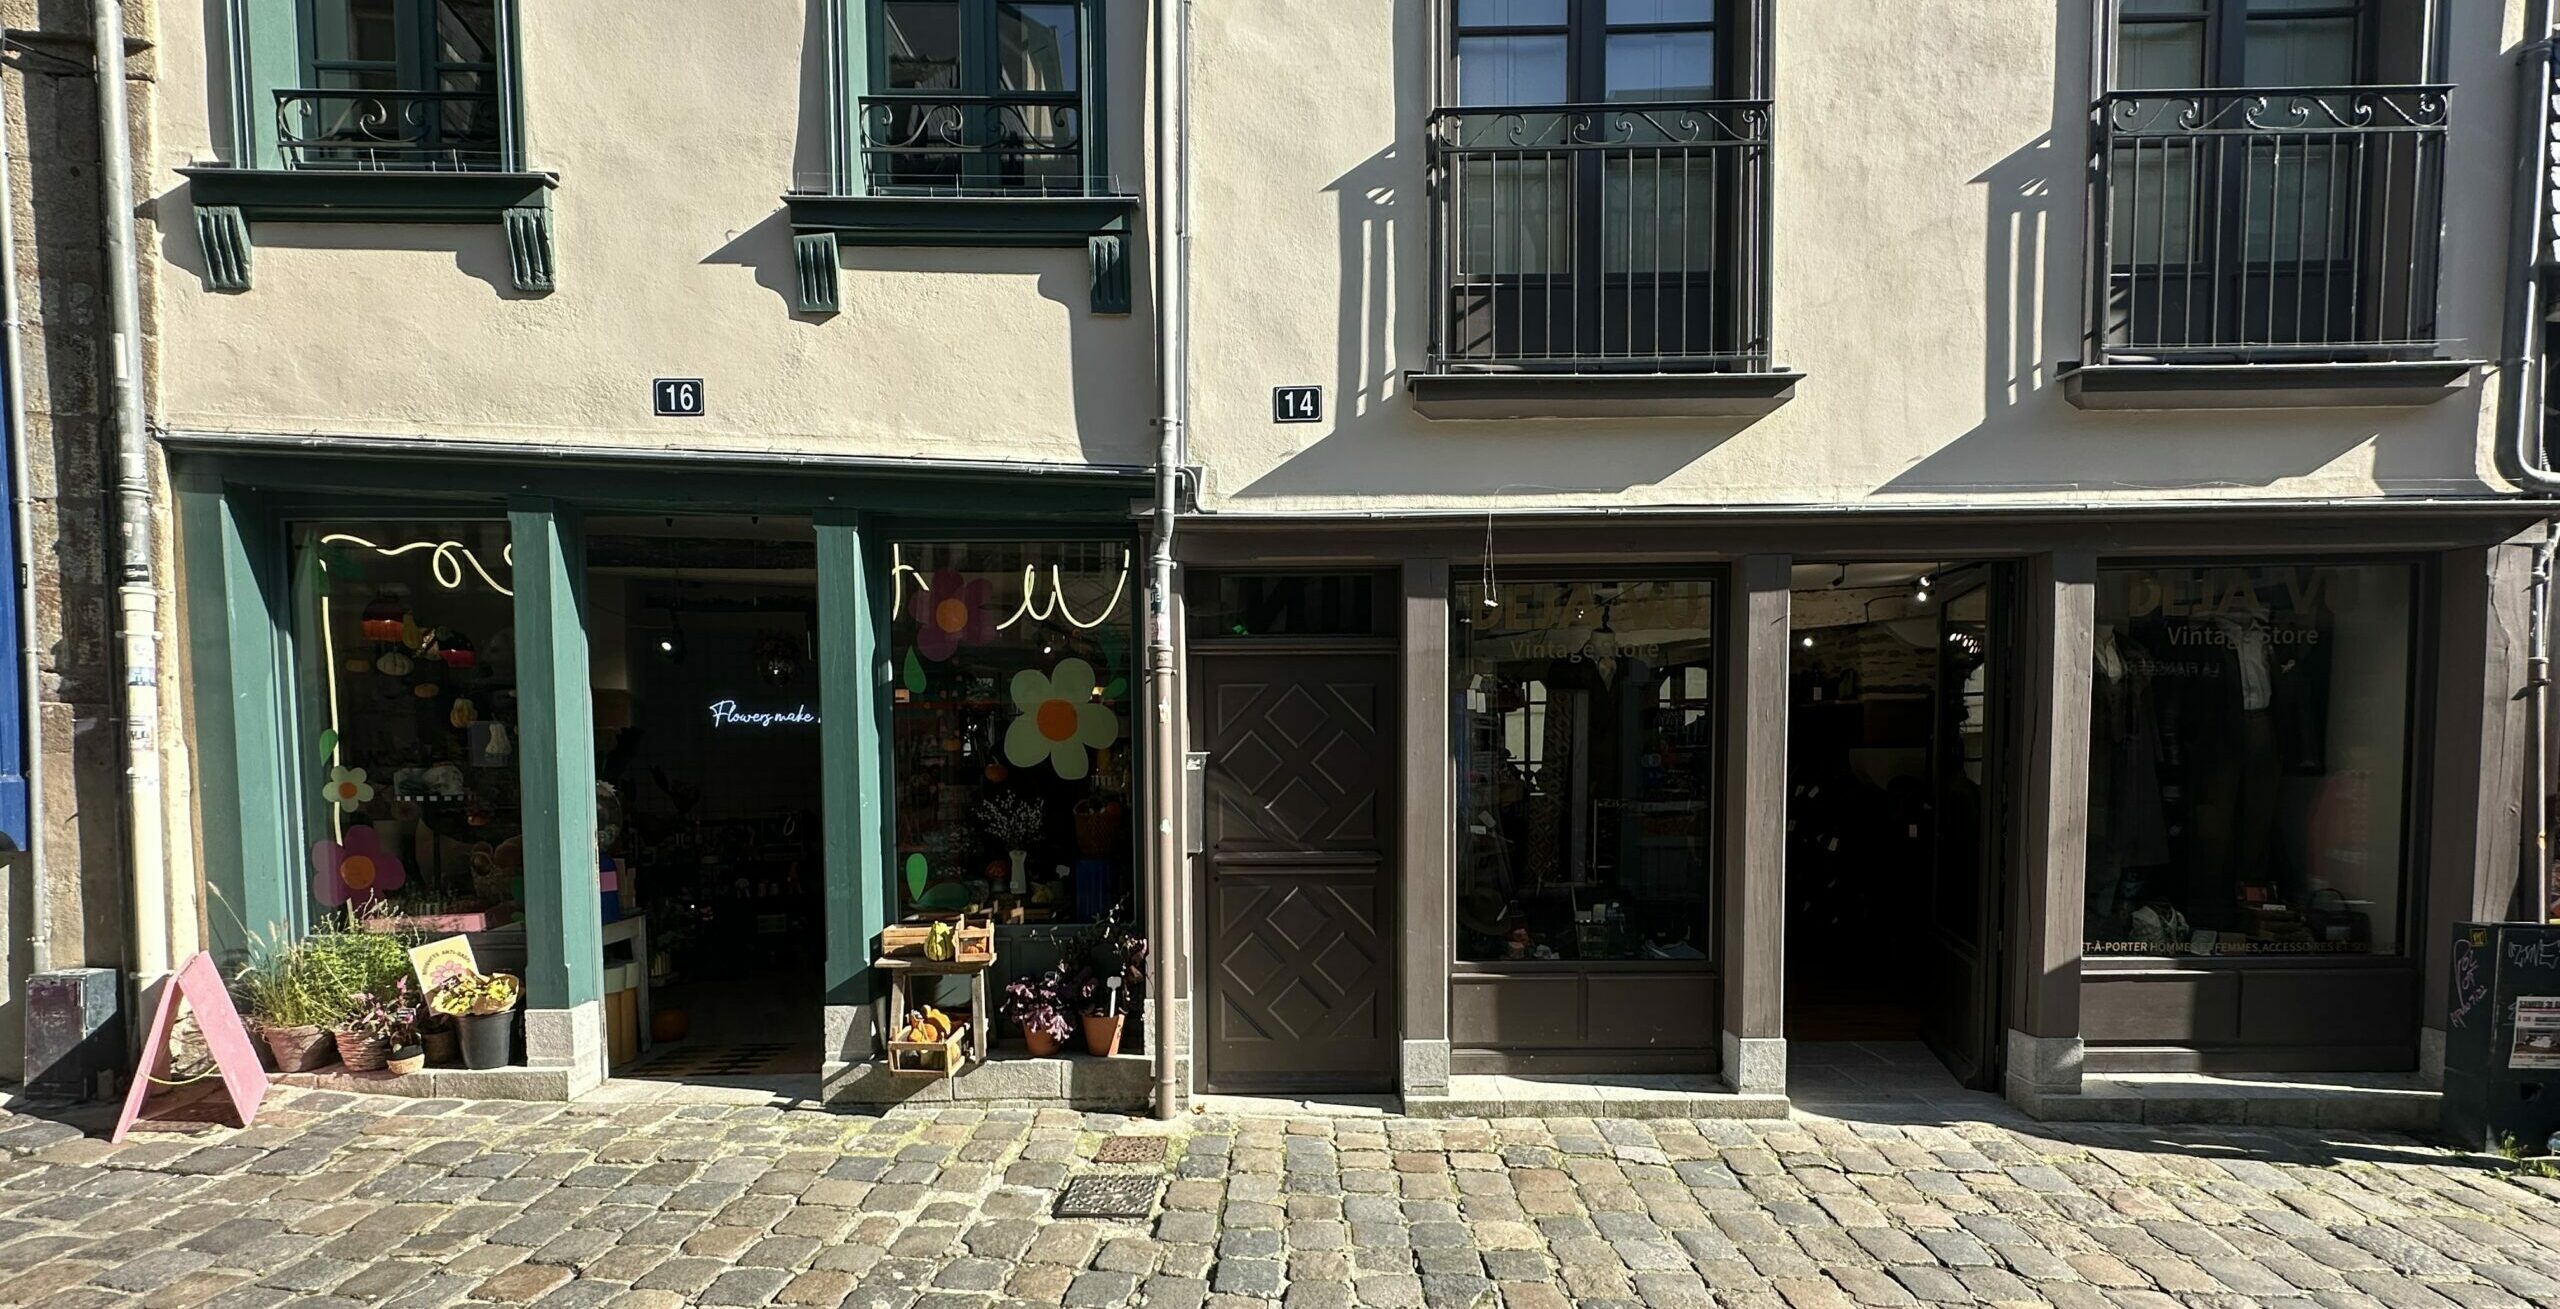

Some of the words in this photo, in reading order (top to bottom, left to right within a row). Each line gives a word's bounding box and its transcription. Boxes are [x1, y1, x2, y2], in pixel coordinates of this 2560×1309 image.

[665, 383, 694, 411] 16
[1284, 390, 1314, 417] 14
[2260, 626, 2320, 645] Store
[1510, 640, 1594, 664] Vintage
[709, 700, 774, 728] Flowers
[774, 704, 814, 722] make
